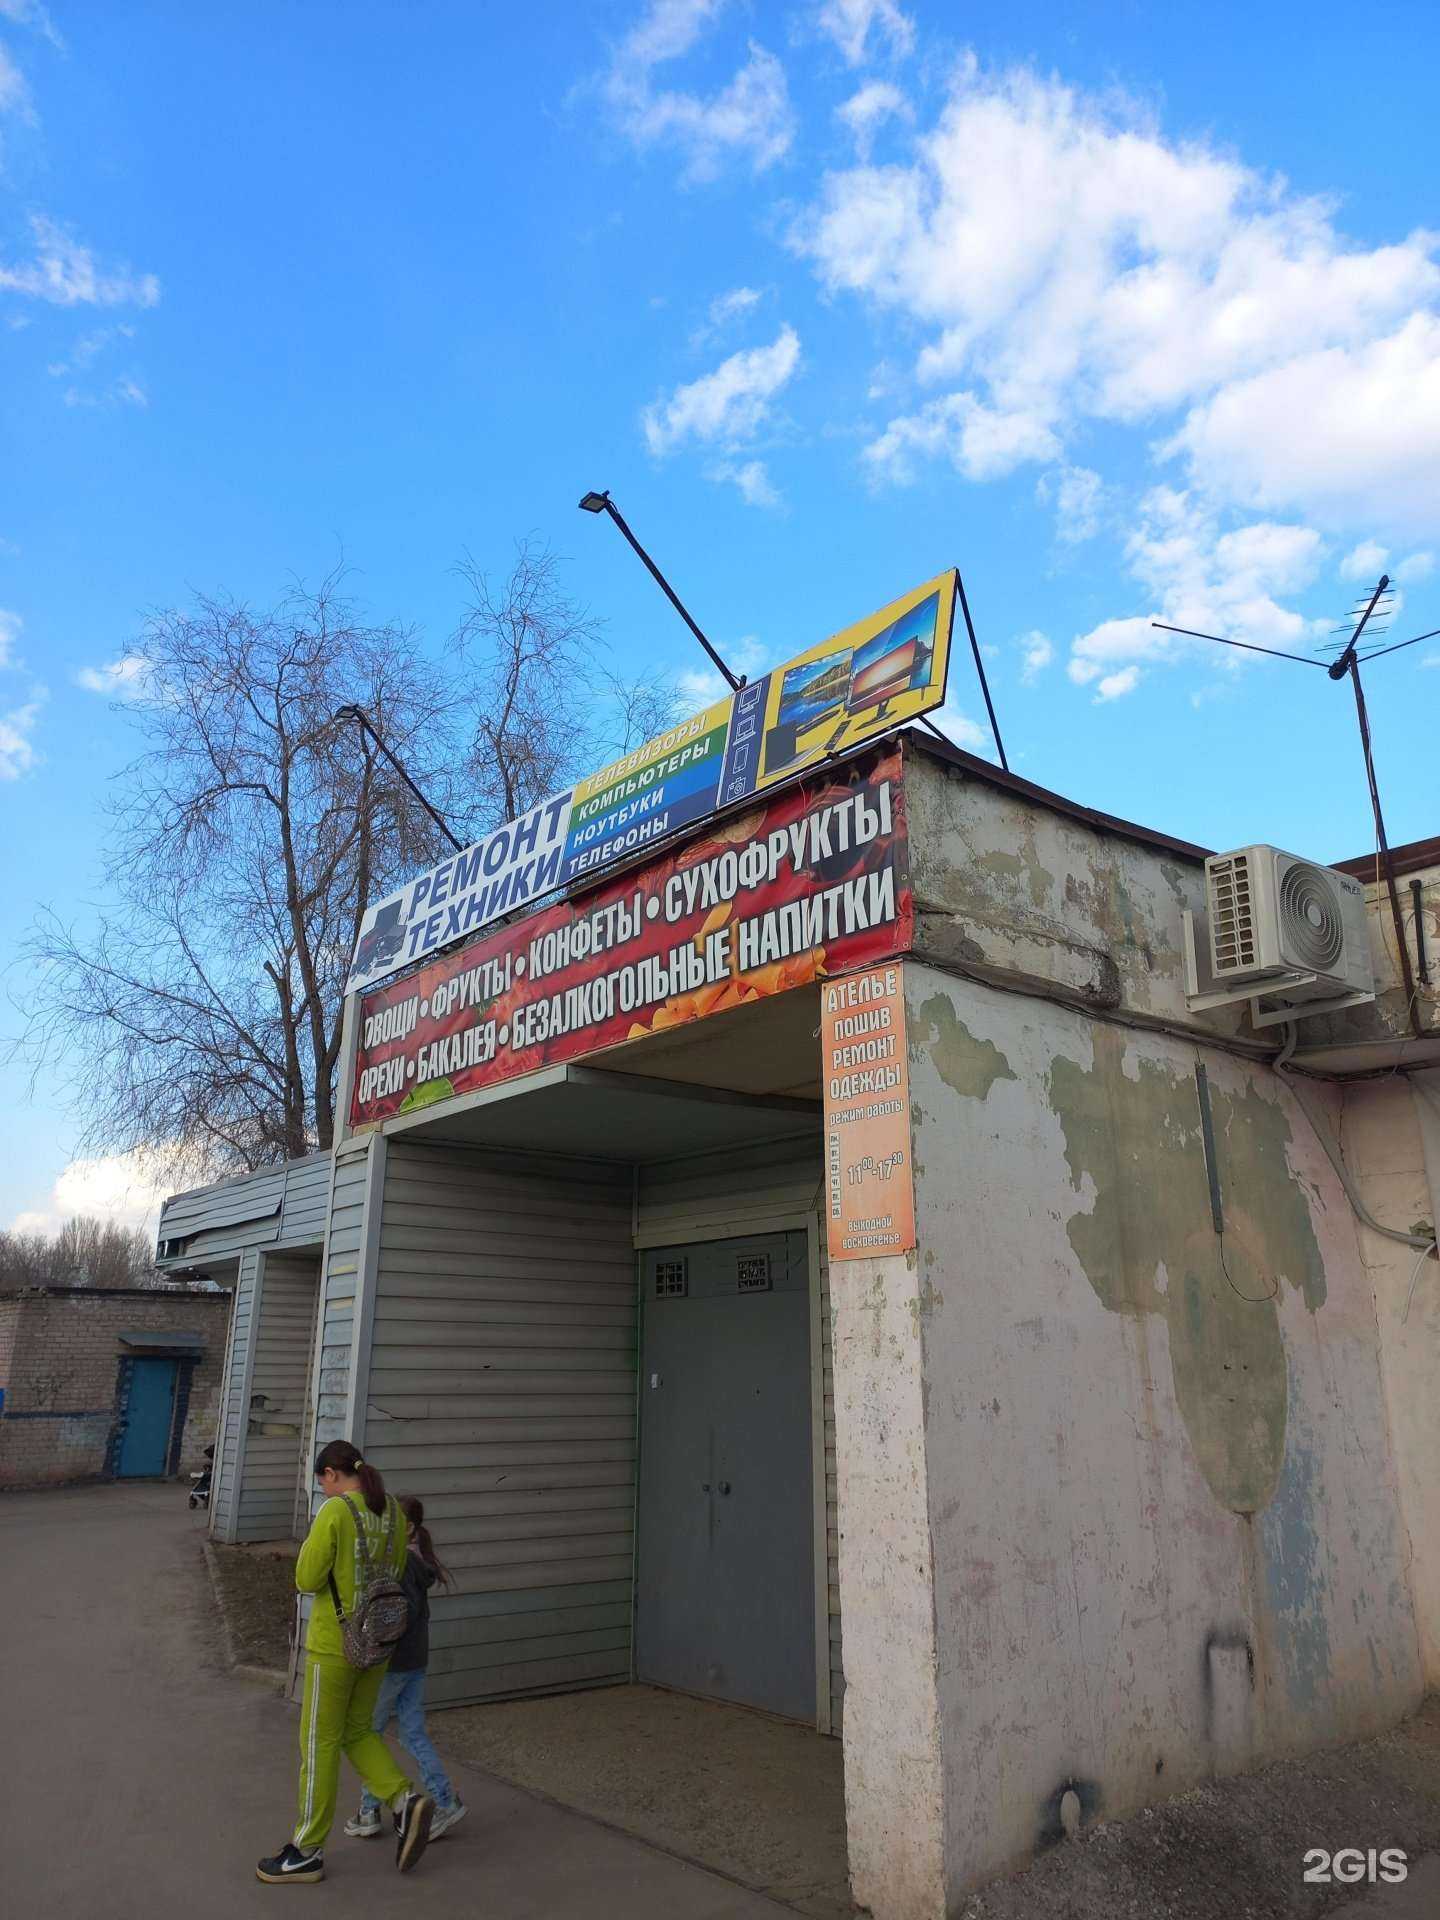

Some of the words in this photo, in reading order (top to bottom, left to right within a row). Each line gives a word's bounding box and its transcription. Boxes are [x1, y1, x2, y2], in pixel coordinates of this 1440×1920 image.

[579, 737, 711, 821] КОМПЬЮТЕРЫ
[586, 714, 706, 793] ТЕЛЕВИЗОРЫ
[569, 812, 669, 874] ТЕЛЕФОНЫ
[573, 786, 664, 848] НОУТБУКИ
[408, 792, 573, 921] РЕМОНТ
[408, 846, 562, 958] ТЕХНИКИ
[431, 953, 511, 1019] ФРУКТЫ
[529, 893, 641, 980] КОНФЕТЫ
[665, 780, 892, 922] СУХОФРУКТЫ
[358, 1055, 405, 1104] ОРЕХИ
[417, 1020, 496, 1083] БАКАЛЕЯ
[512, 928, 730, 1050] БЕЗАЛКОГОЛЬНЫЕ
[739, 866, 895, 971] НАПИТКИ
[827, 969, 896, 1013] АТЕЛЬЕ
[832, 1034, 896, 1070] РЕМОНТ
[834, 1006, 891, 1041] ПОШИВ
[829, 1107, 864, 1126] режим
[866, 1099, 903, 1120] работы
[830, 1063, 901, 1101] ОДЕЖДЫ
